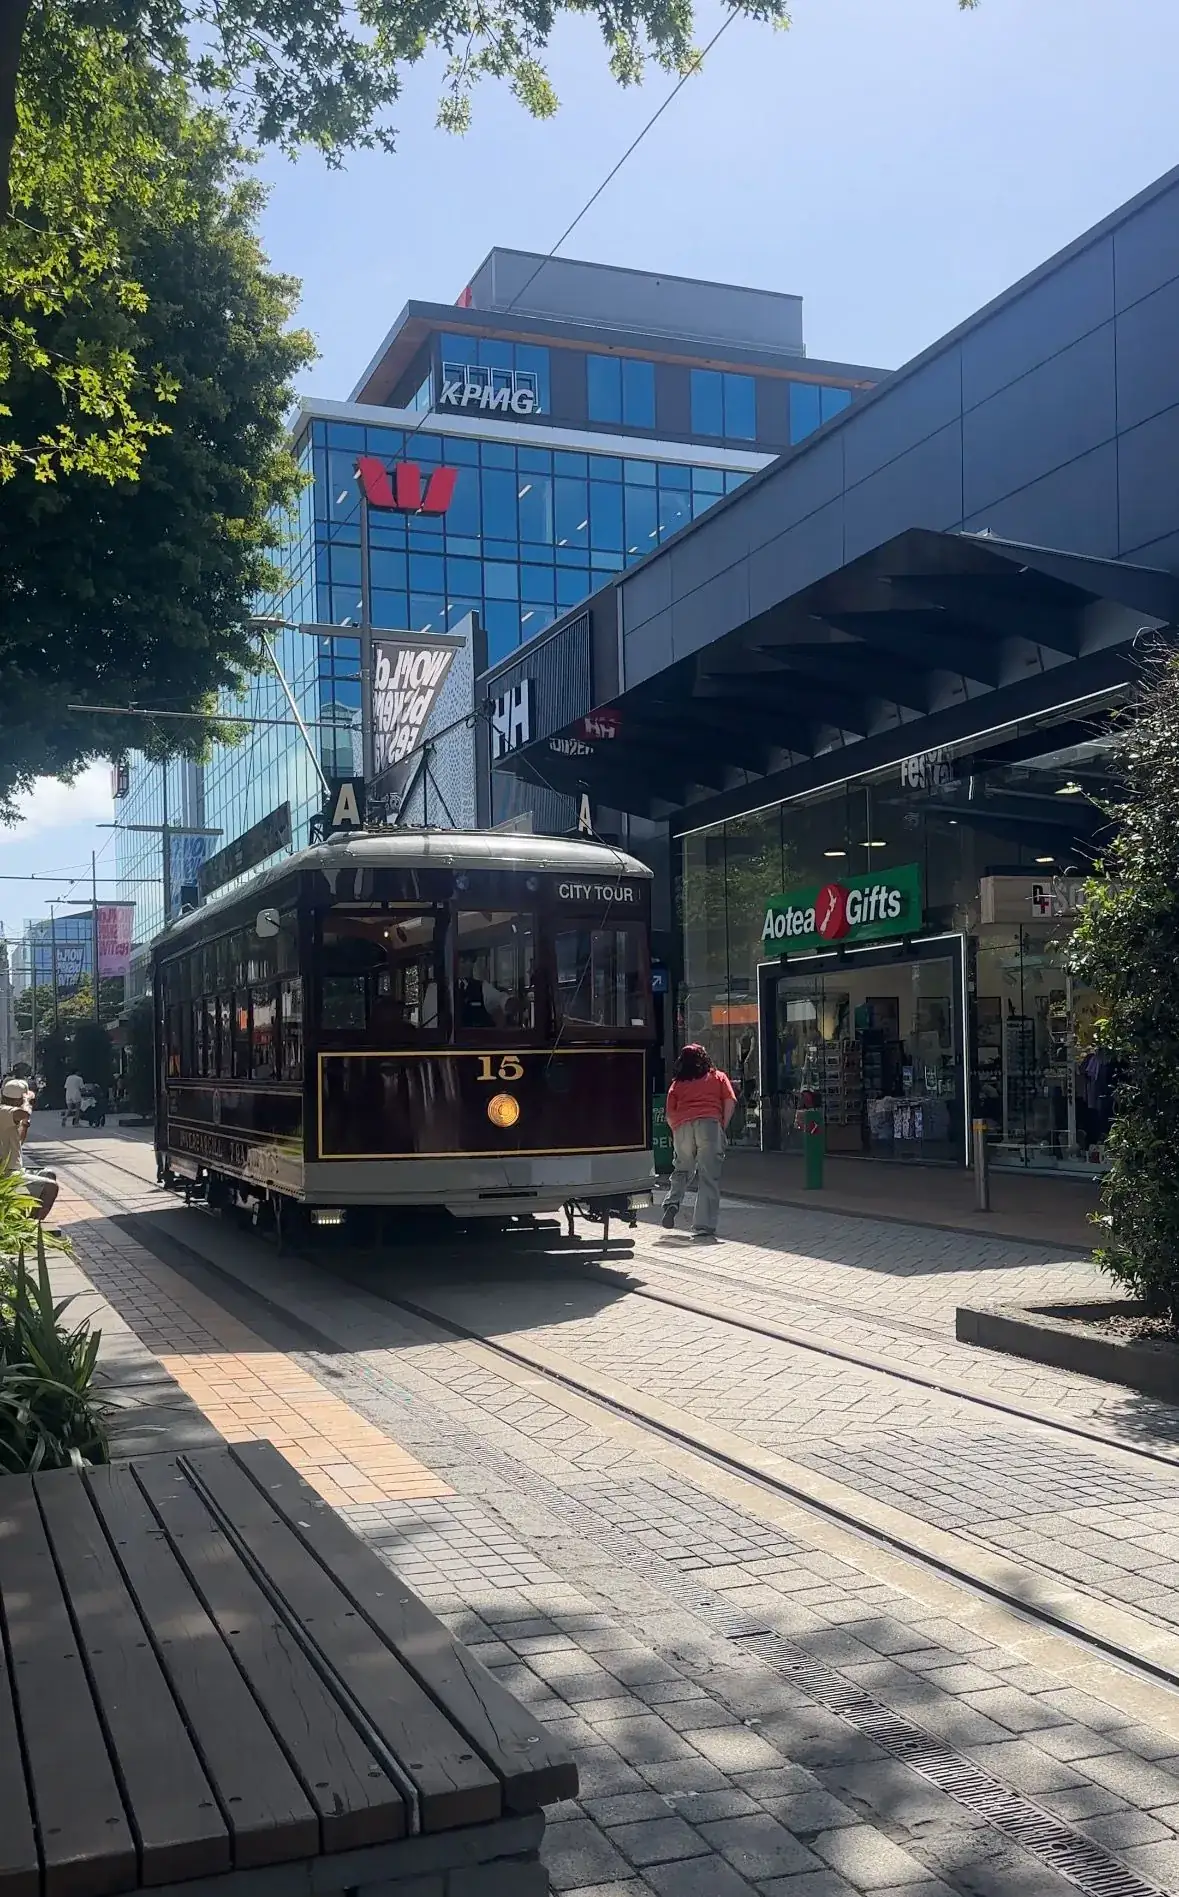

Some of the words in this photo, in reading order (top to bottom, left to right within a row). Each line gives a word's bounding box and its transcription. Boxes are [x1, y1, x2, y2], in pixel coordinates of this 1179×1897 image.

[440, 380, 534, 415] KPMG
[332, 783, 361, 826] A
[578, 792, 593, 836] A
[559, 883, 591, 900] CITY
[595, 884, 634, 902] TOUR
[761, 905, 816, 941] Aotea
[845, 884, 902, 926] Gifts
[476, 1055, 525, 1081] 15
